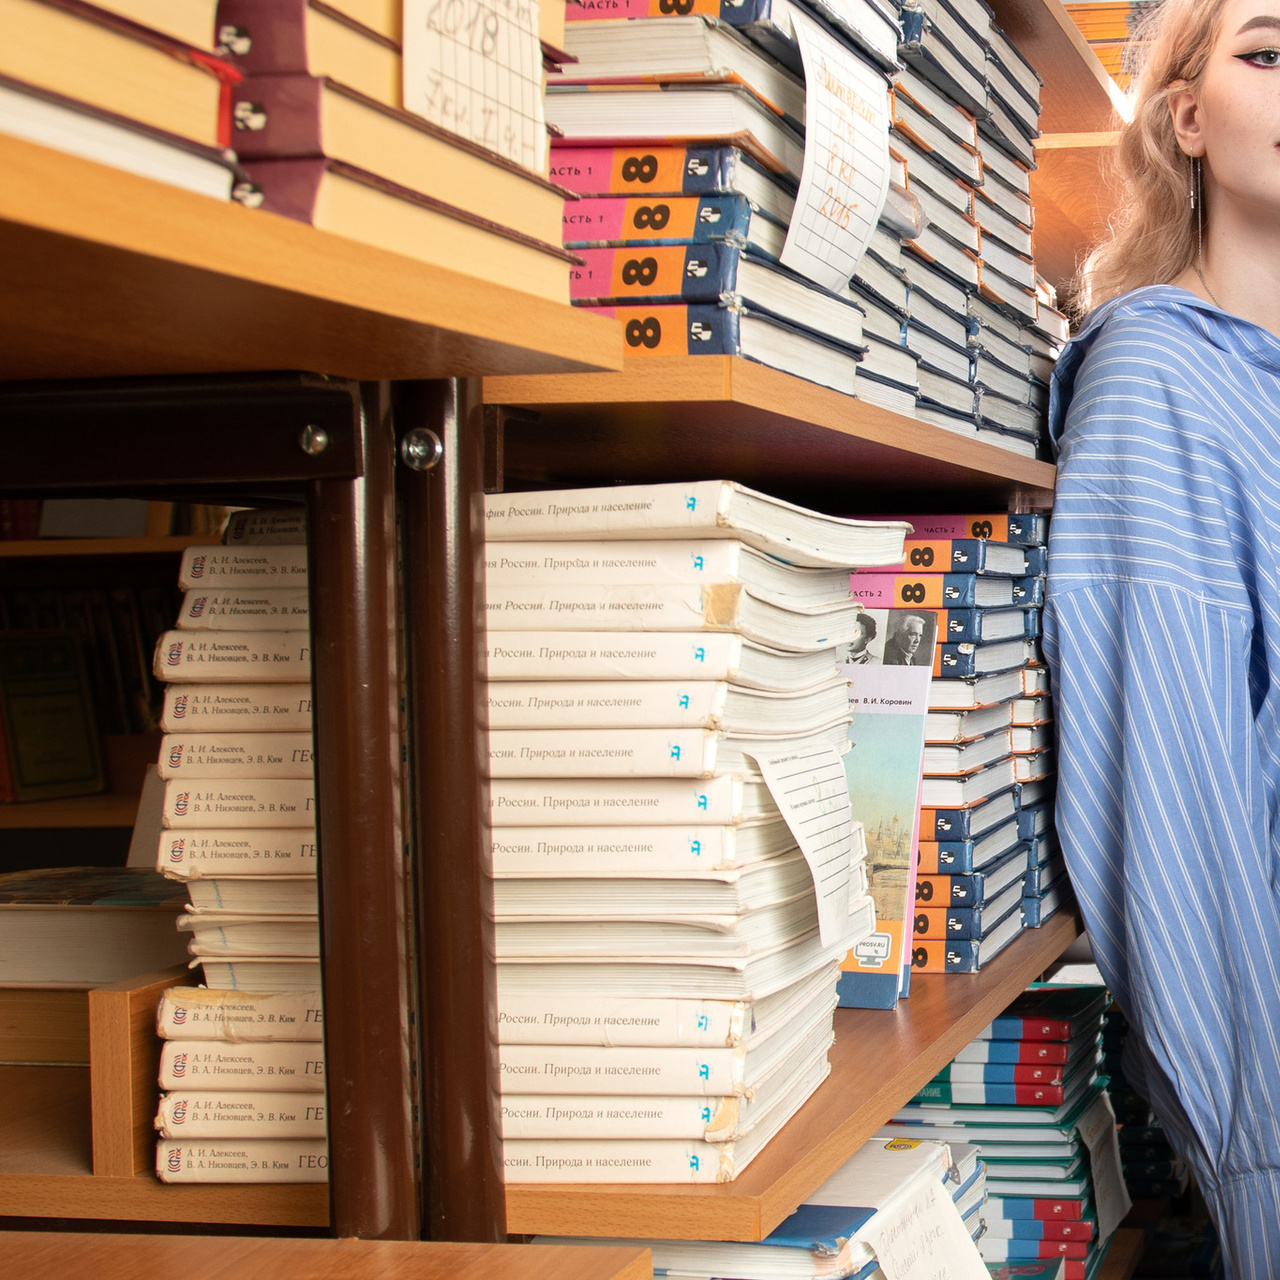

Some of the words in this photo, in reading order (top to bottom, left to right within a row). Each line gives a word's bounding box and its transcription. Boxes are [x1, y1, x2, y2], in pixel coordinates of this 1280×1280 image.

[550, 167, 581, 175] АСТЬ
[622, 155, 658, 183] 8
[633, 204, 670, 230] 8
[622, 257, 658, 286] 8
[626, 316, 661, 348] 8
[507, 506, 545, 518] России.
[547, 504, 590, 517] Природа
[601, 501, 652, 512] население
[971, 520, 993, 539] 8
[910, 546, 934, 567] 8
[901, 583, 926, 604] 8
[493, 648, 535, 658] России.
[539, 648, 587, 660] Природа
[600, 649, 656, 658] население
[214, 696, 251, 704] Алексеев,
[880, 698, 912, 706] Коровин
[212, 706, 250, 715] Низовцев,
[273, 706, 289, 714] Ким
[498, 797, 539, 807] России.
[543, 797, 590, 809] Природа
[603, 798, 659, 807] население
[215, 1101, 255, 1110] Алексеев,
[214, 1113, 254, 1121] Низовцев,
[279, 1113, 296, 1121] Ким
[501, 1107, 542, 1118] России.
[546, 1108, 594, 1120] Природа
[606, 1109, 663, 1119] население
